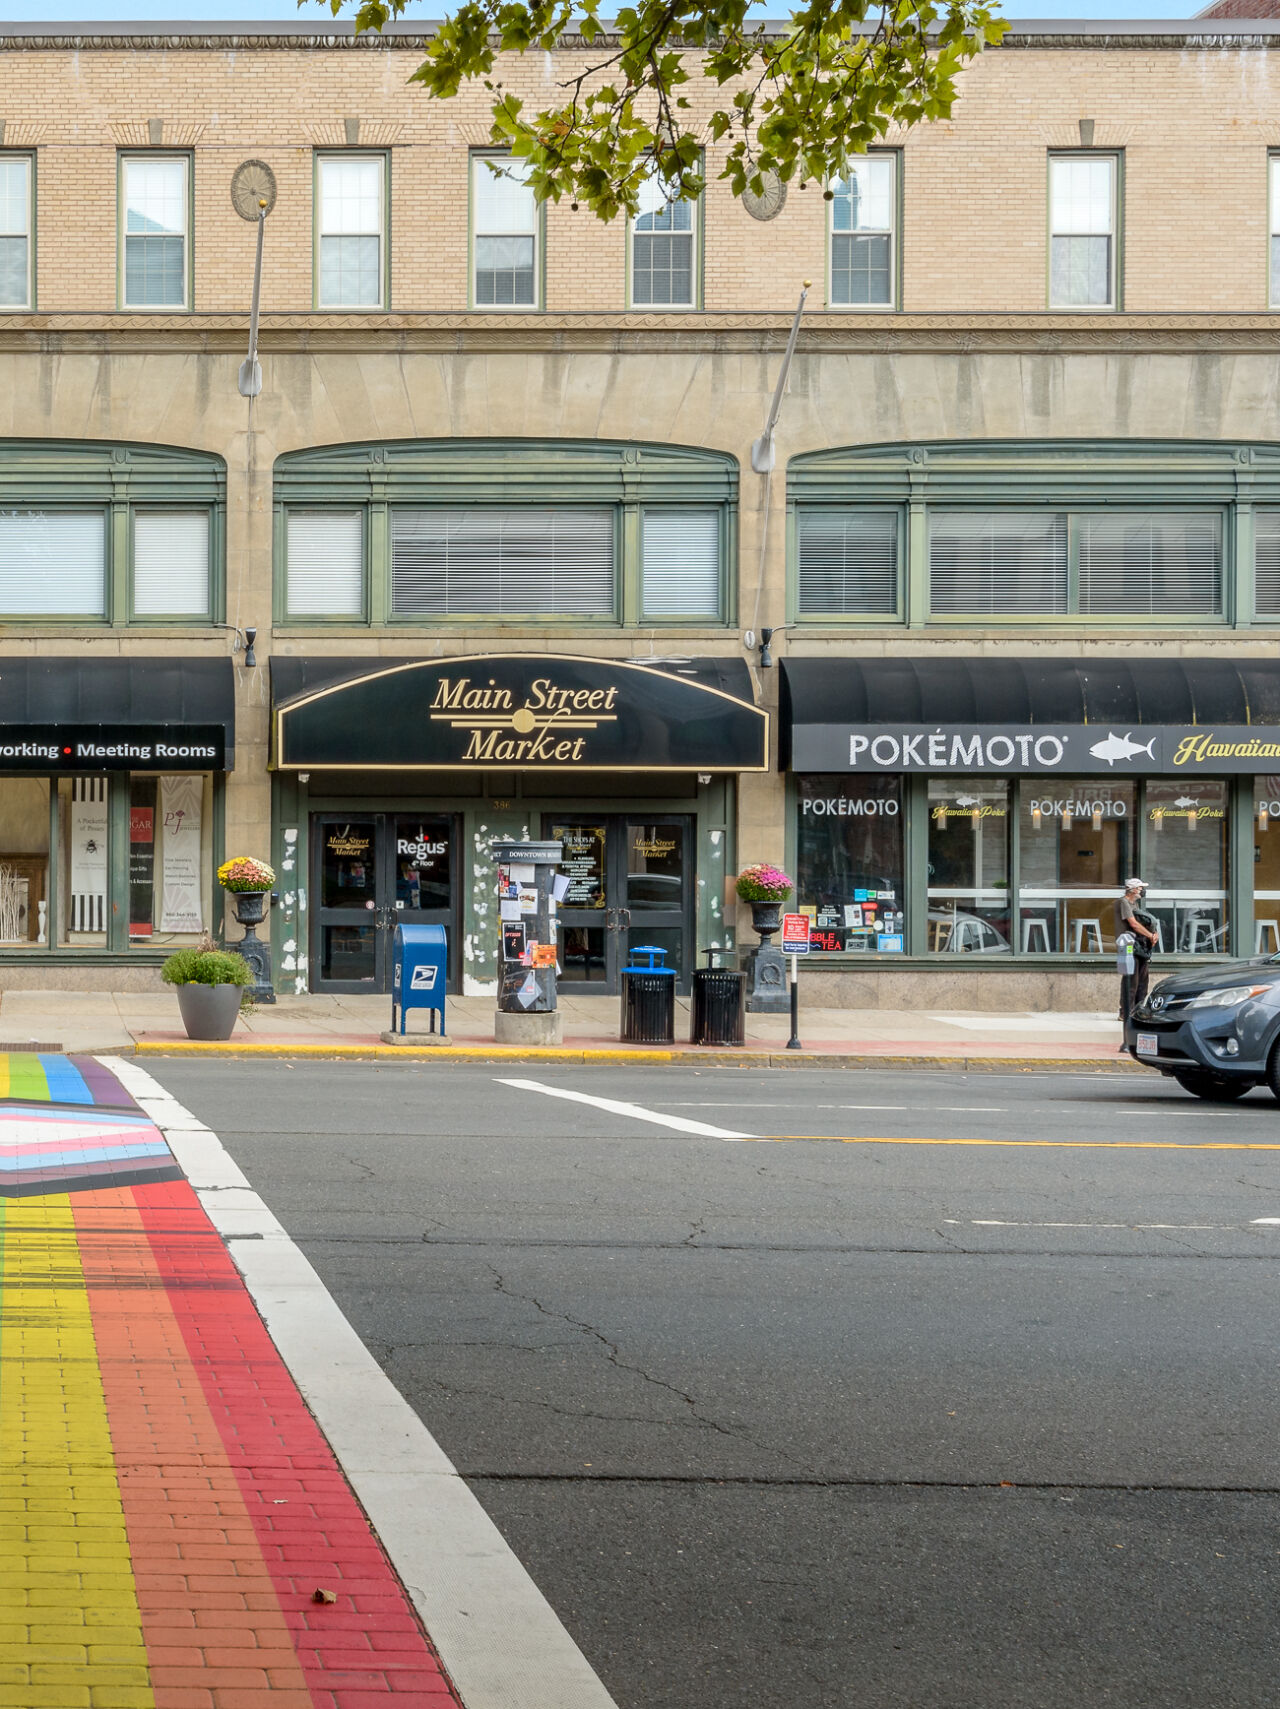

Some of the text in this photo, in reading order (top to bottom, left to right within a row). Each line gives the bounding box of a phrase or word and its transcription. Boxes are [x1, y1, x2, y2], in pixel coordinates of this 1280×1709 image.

[429, 679, 619, 710] Main Street
[462, 711, 586, 761] Market
[77, 742, 151, 759] Meeting
[155, 742, 216, 757] Rooms
[803, 796, 898, 815] POKÉMOTO
[328, 836, 370, 845] Main Street
[635, 838, 676, 846] Main Street
[509, 850, 546, 858] DOWNTOWN
[810, 932, 836, 942] BBLE
[822, 941, 842, 951] TEA
